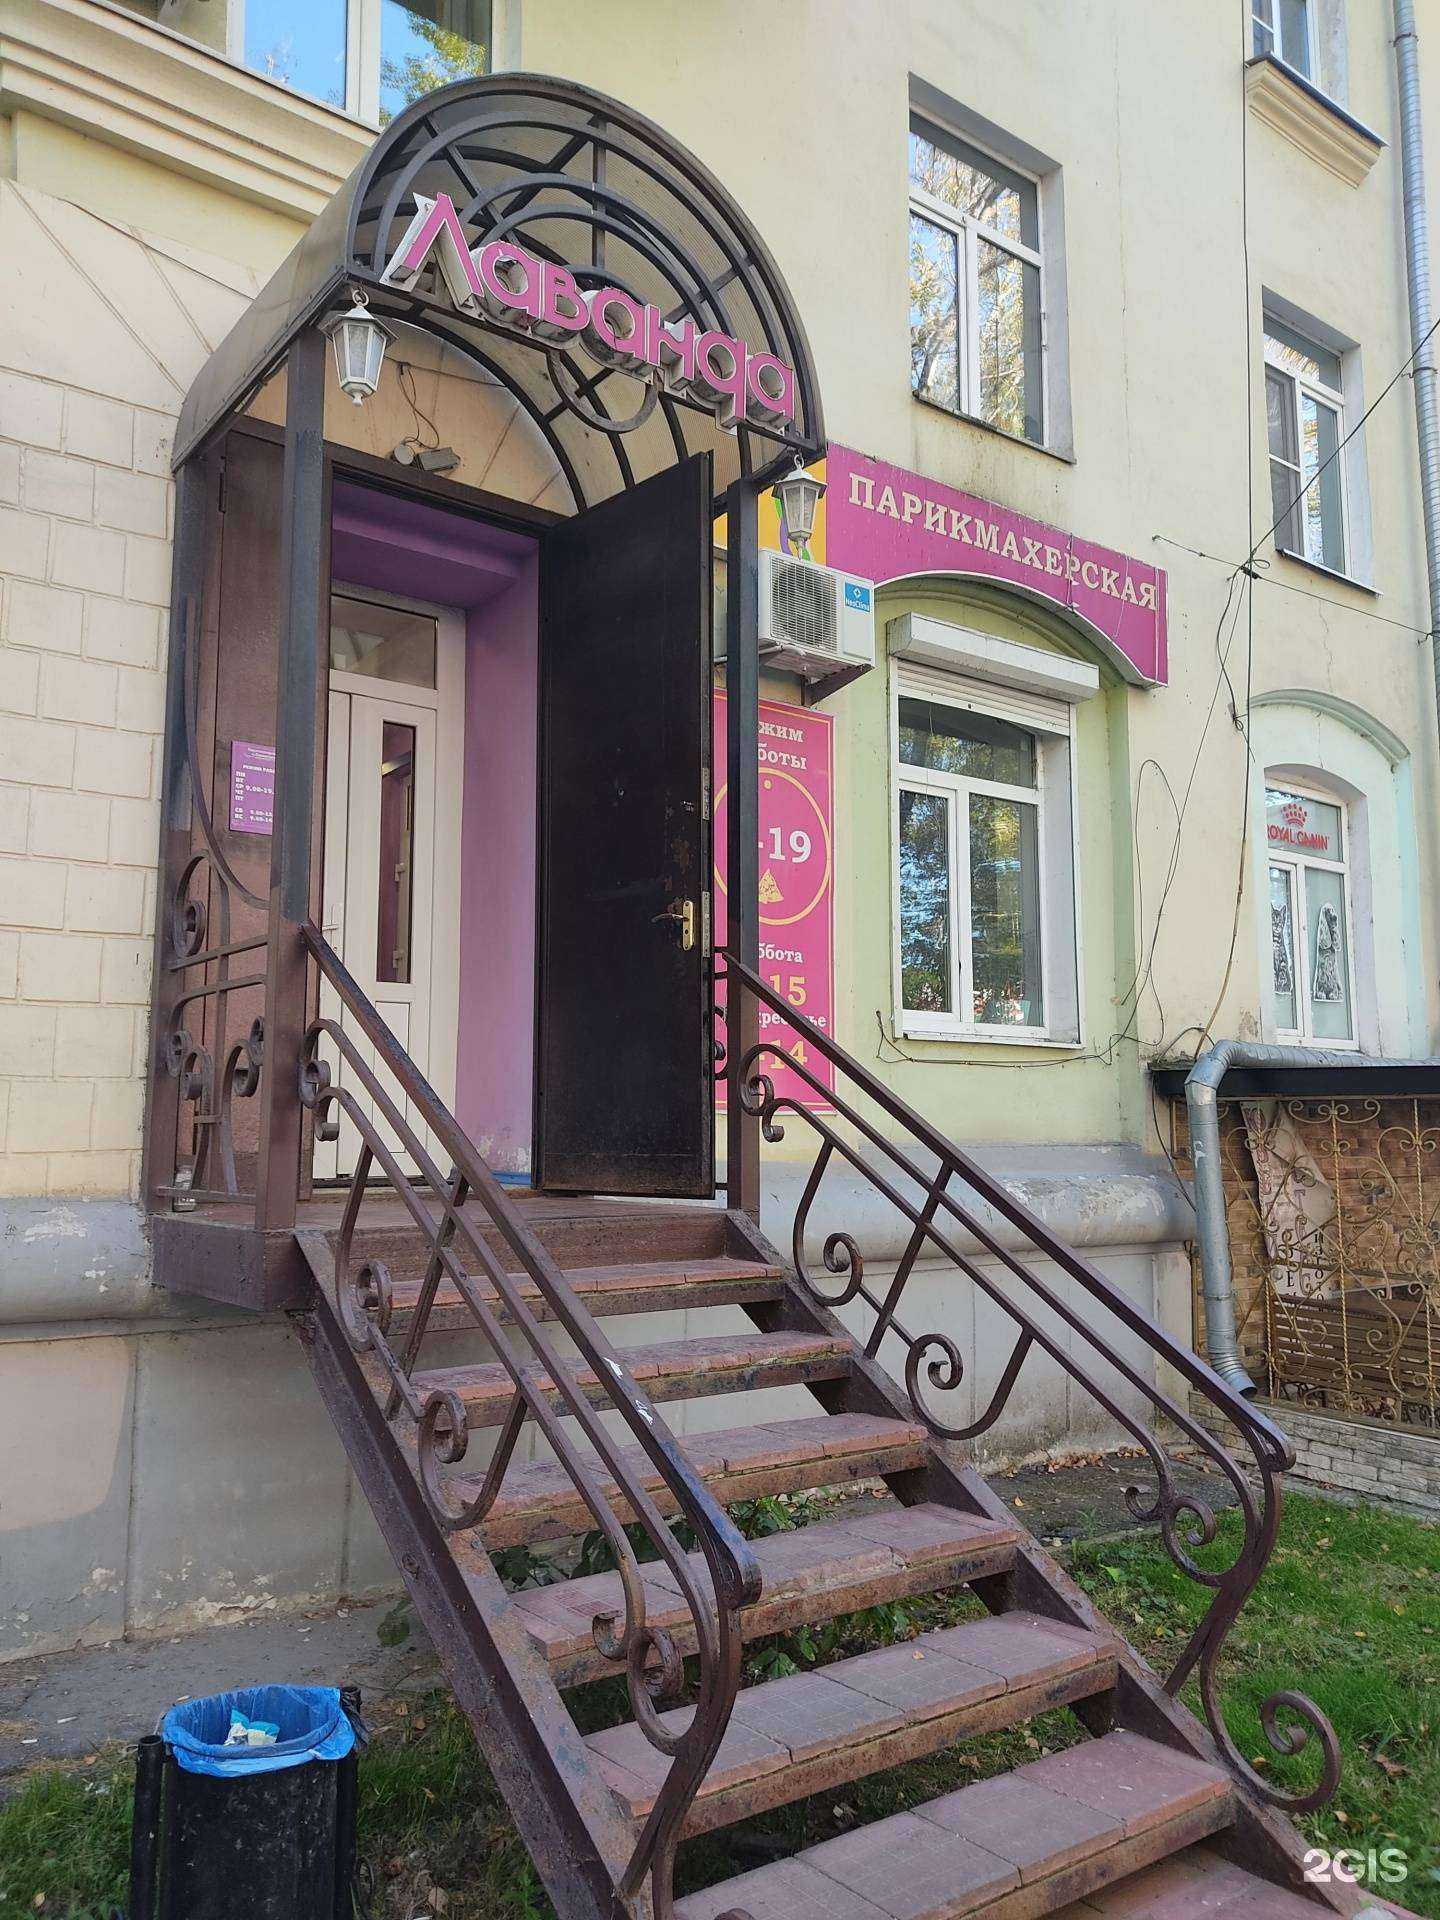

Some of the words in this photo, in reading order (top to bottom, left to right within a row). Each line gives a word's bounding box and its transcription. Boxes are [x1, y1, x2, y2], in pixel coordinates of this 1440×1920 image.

[849, 472, 1157, 610] ПАРИКМАХЕРСКАЯ
[758, 722, 803, 742] жим
[758, 743, 807, 769] боты
[758, 827, 812, 863] -19
[1267, 824, 1297, 844] OYAL
[769, 974, 808, 1006] 15
